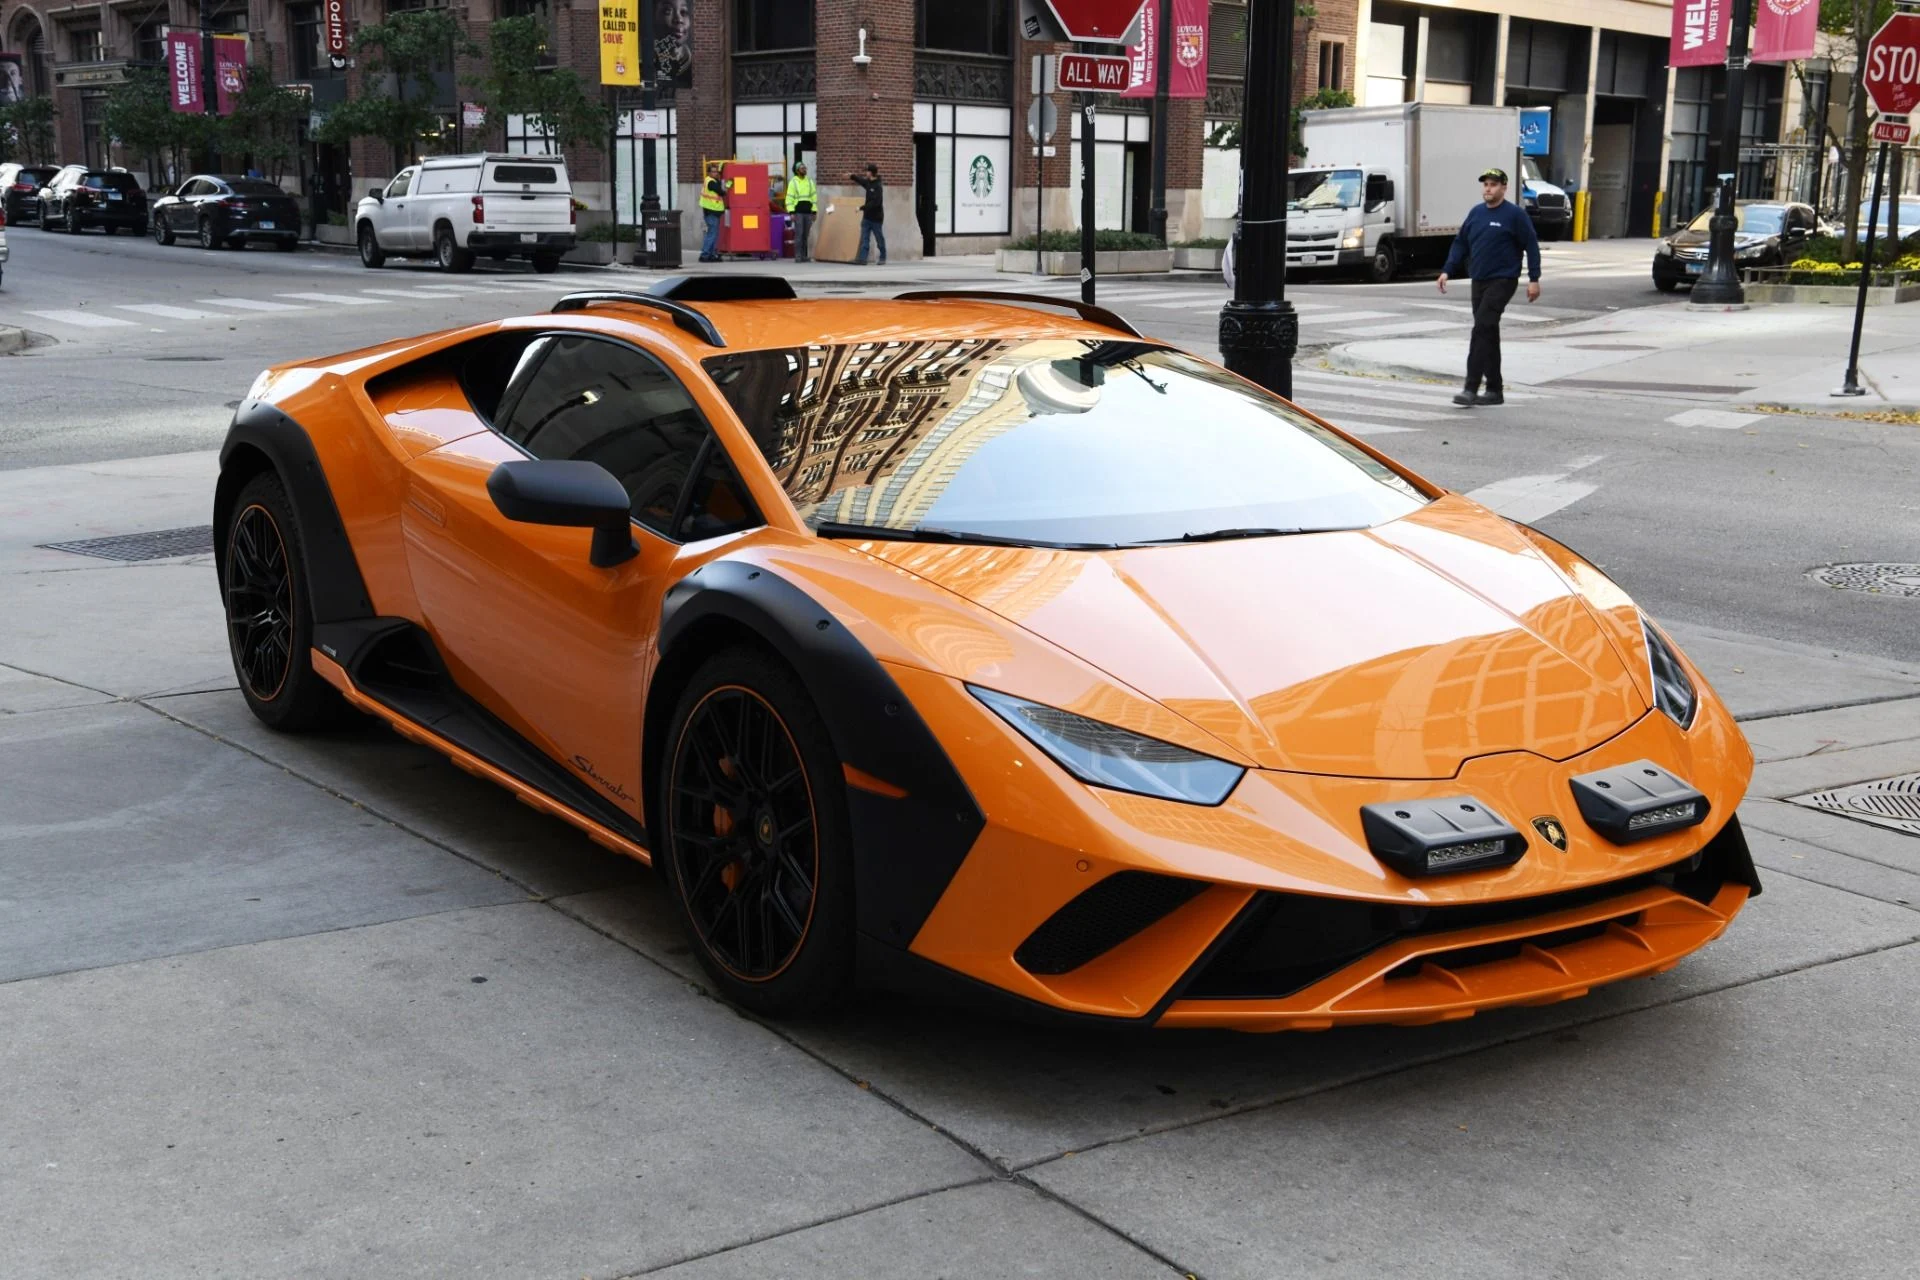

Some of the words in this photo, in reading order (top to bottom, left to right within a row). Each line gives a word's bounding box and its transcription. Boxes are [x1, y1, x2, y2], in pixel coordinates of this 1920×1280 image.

[330, 0, 343, 49] CHIPO
[602, 8, 613, 18] WE
[615, 8, 627, 18] ARE
[602, 20, 626, 31] CALLED
[628, 22, 636, 32] TO
[603, 32, 623, 44] SOLVE
[1707, 10, 1719, 42] WATER
[1130, 7, 1147, 88] WELC
[1147, 36, 1155, 60] TOWER
[174, 41, 190, 105] WELCOME
[1066, 62, 1092, 83] ALL
[1098, 64, 1124, 85] WAY
[1146, 61, 1154, 83] WATER
[1869, 45, 1920, 84] STO
[1876, 125, 1890, 138] ALL
[1892, 127, 1908, 140] WAY
[567, 755, 636, 804] Sterrato
